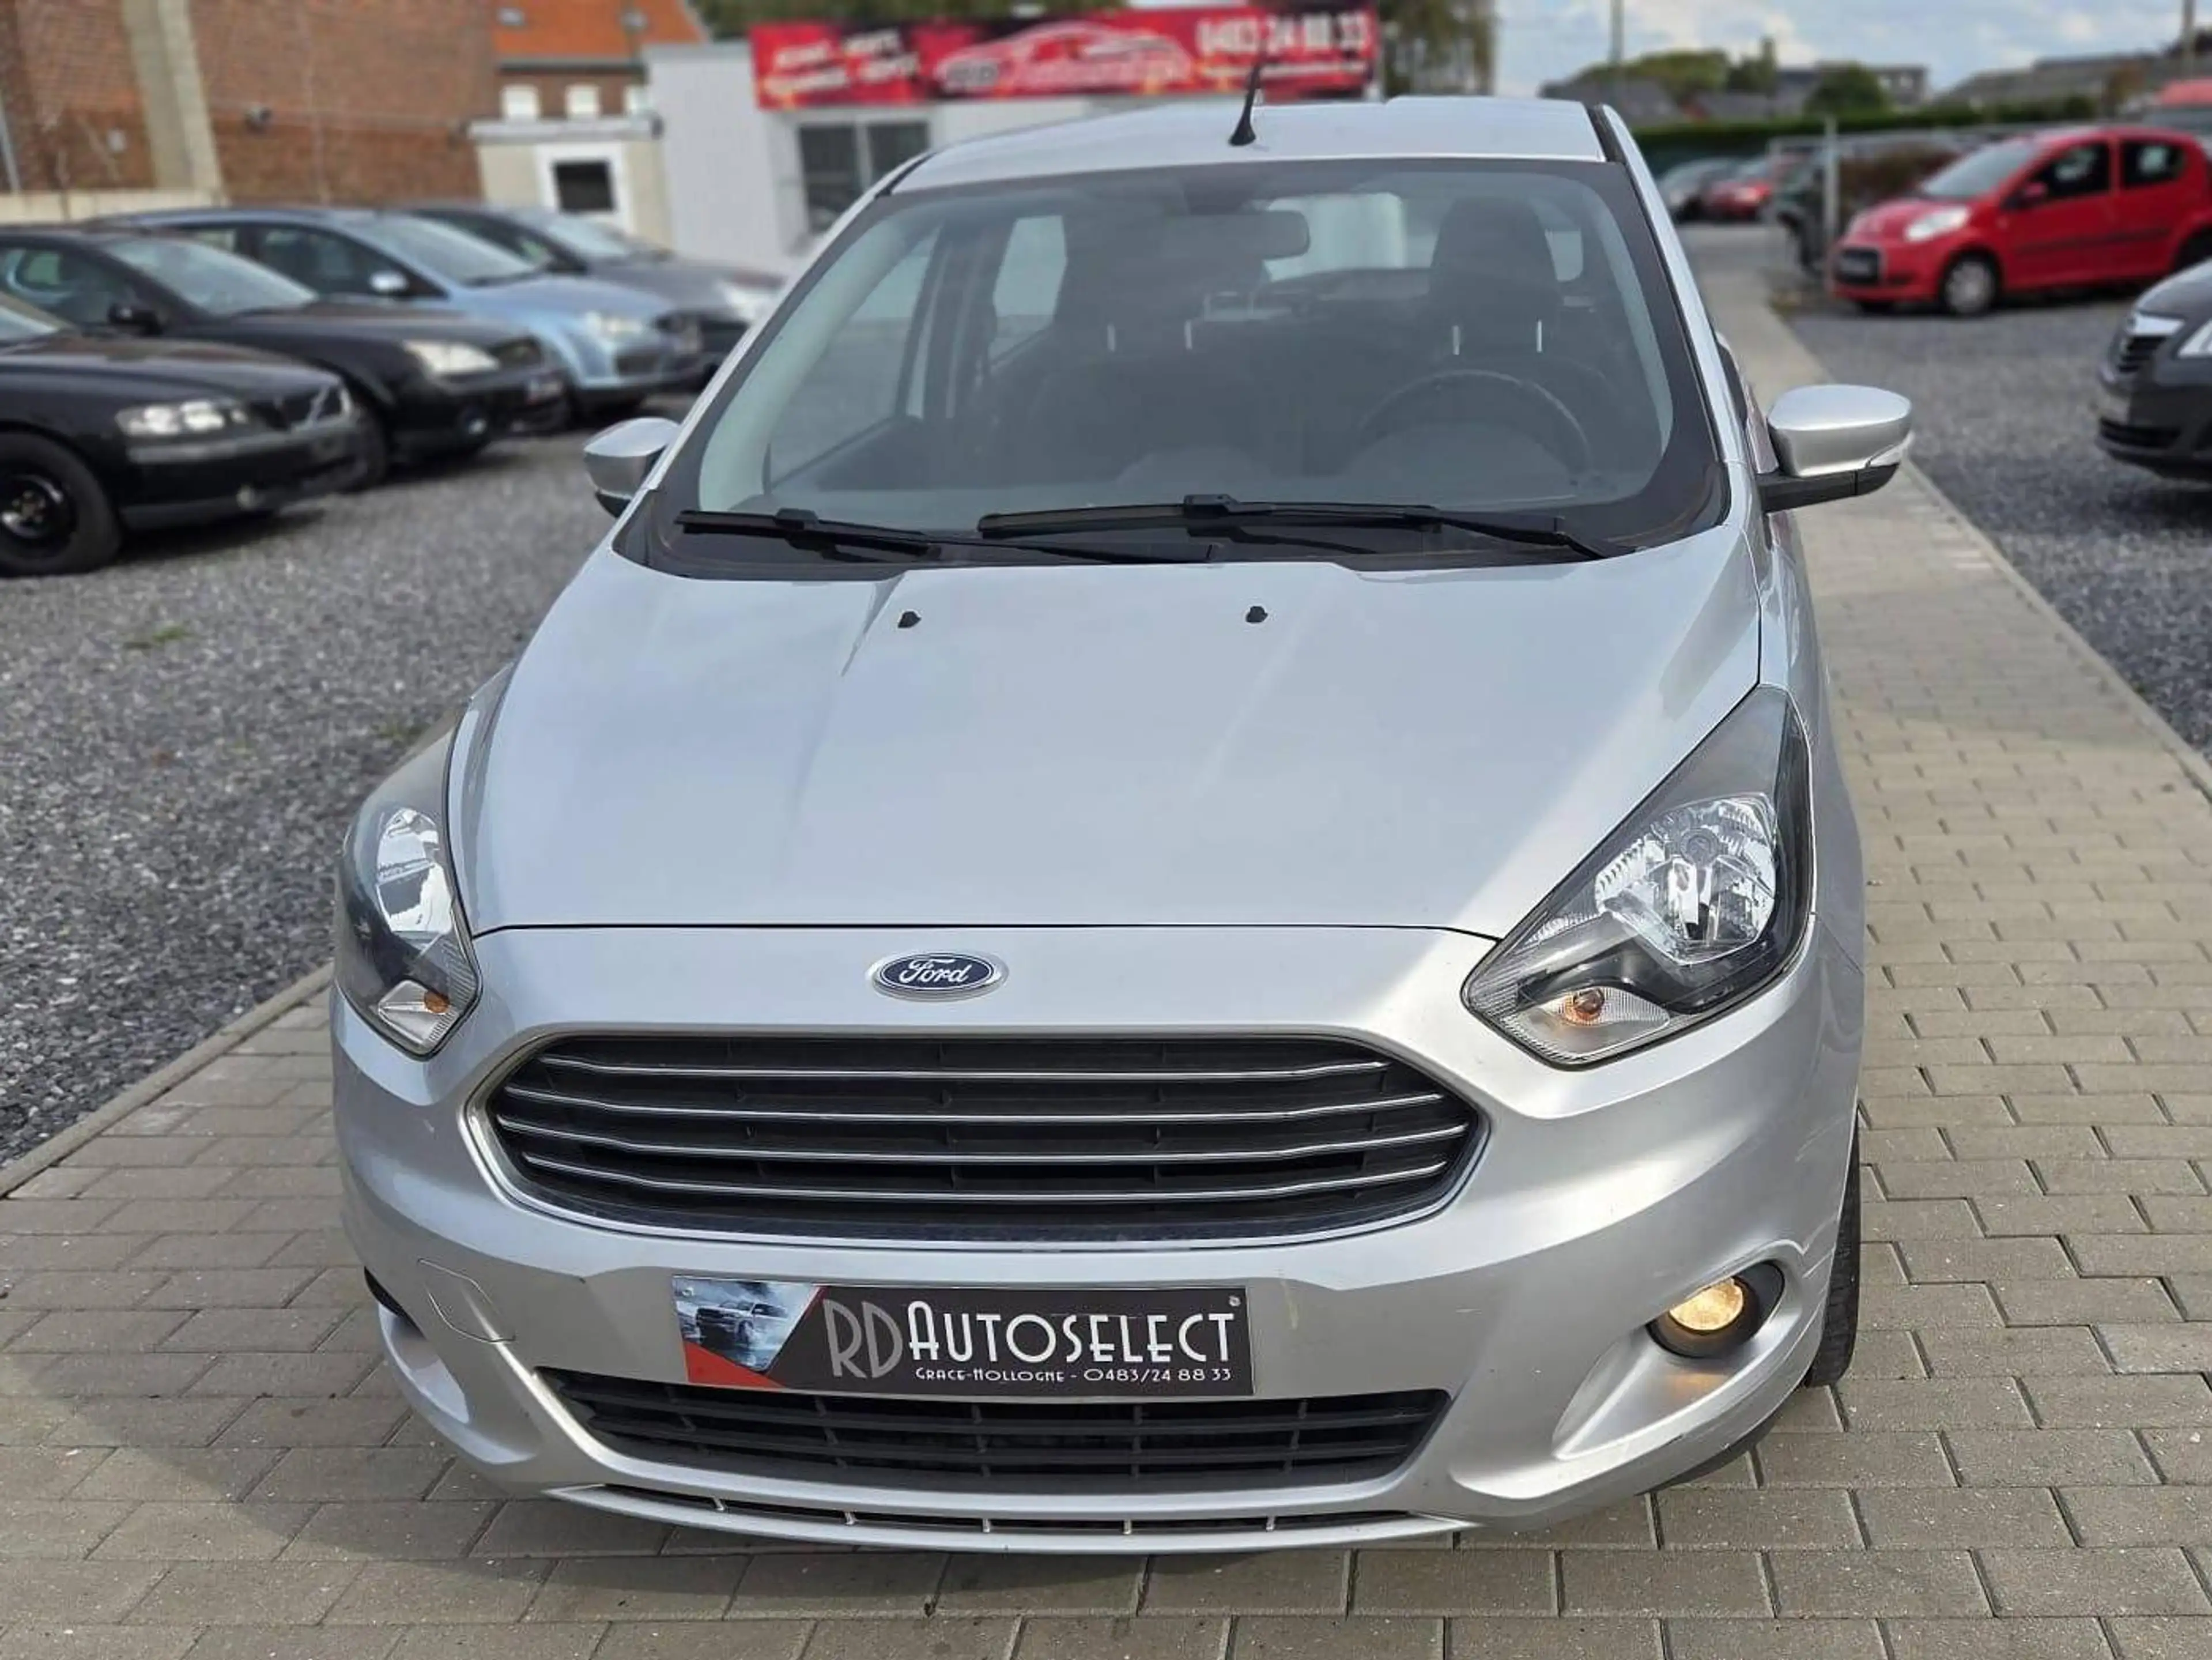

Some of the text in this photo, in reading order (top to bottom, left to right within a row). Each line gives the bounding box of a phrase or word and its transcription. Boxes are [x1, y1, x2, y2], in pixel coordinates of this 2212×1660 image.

[899, 959, 972, 983] Ford
[1084, 1368, 1171, 1383] 0483/24
[1177, 1368, 1206, 1382] 88
[1211, 1368, 1232, 1382] 33
